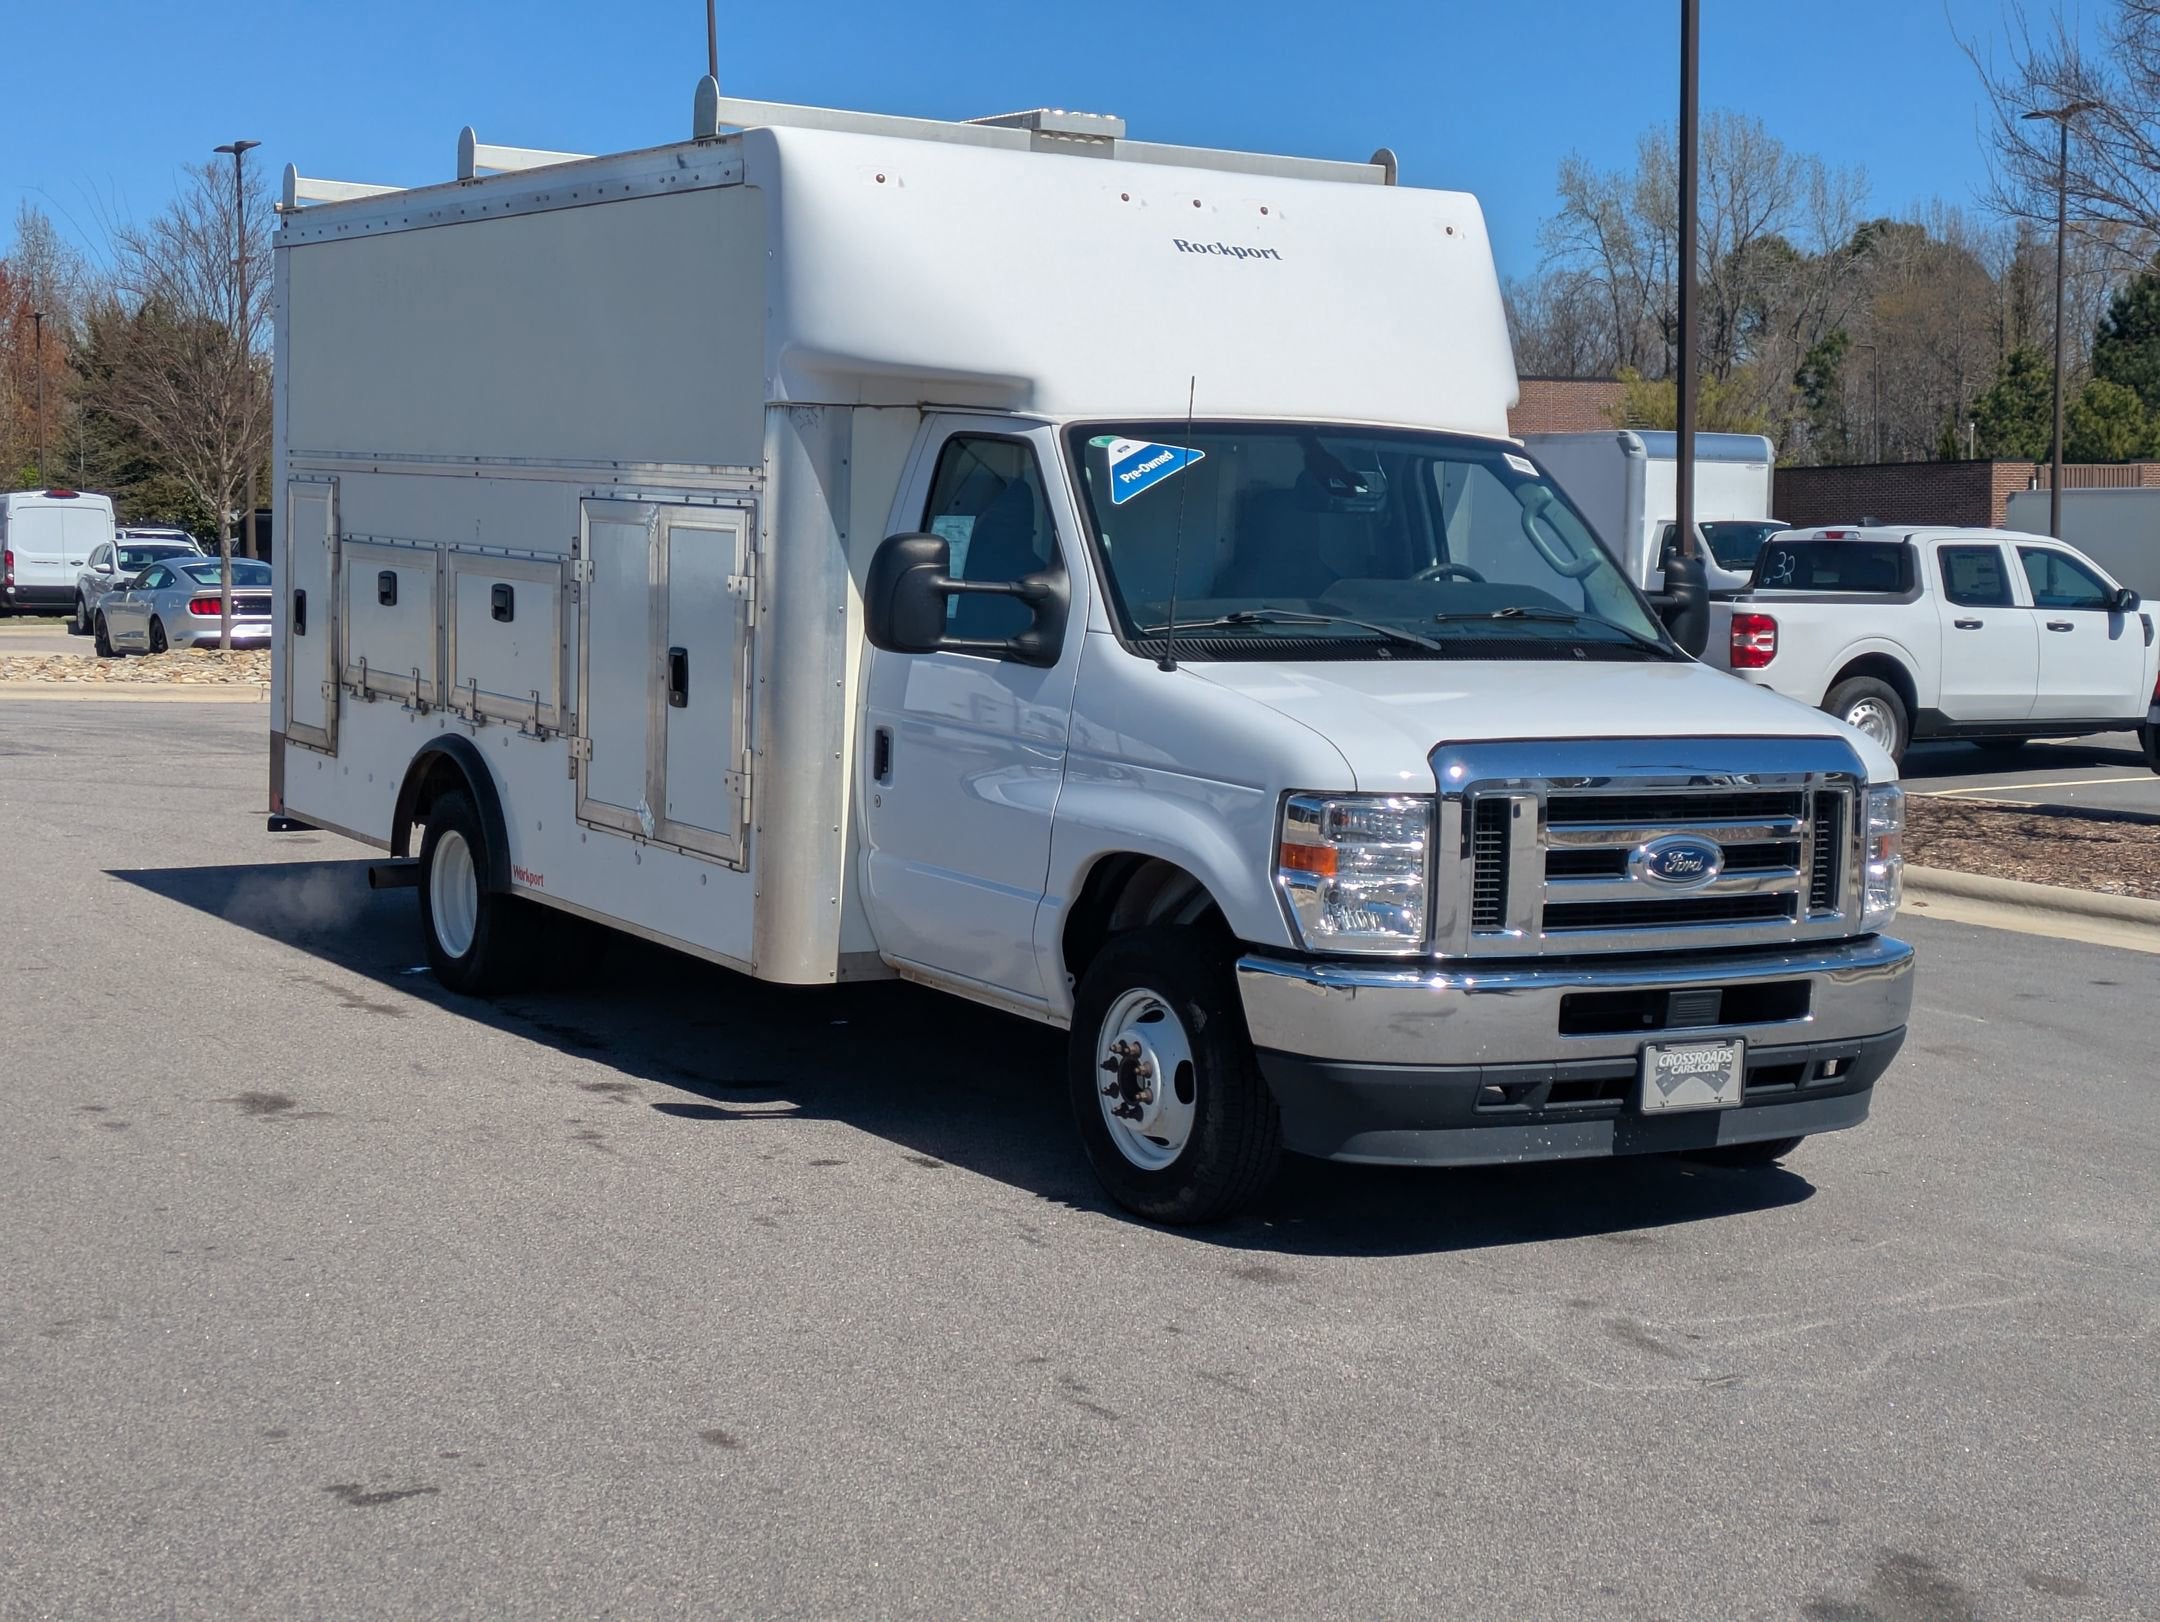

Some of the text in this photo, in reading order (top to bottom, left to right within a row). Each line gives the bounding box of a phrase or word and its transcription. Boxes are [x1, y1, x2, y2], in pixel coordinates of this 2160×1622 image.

[1172, 238, 1284, 261] Rockport
[1119, 449, 1175, 484] Pre-Owned
[1664, 850, 1704, 873] Ford
[1658, 1049, 1734, 1068] CROSSROADS
[1671, 1062, 1719, 1075] CARS.COM
